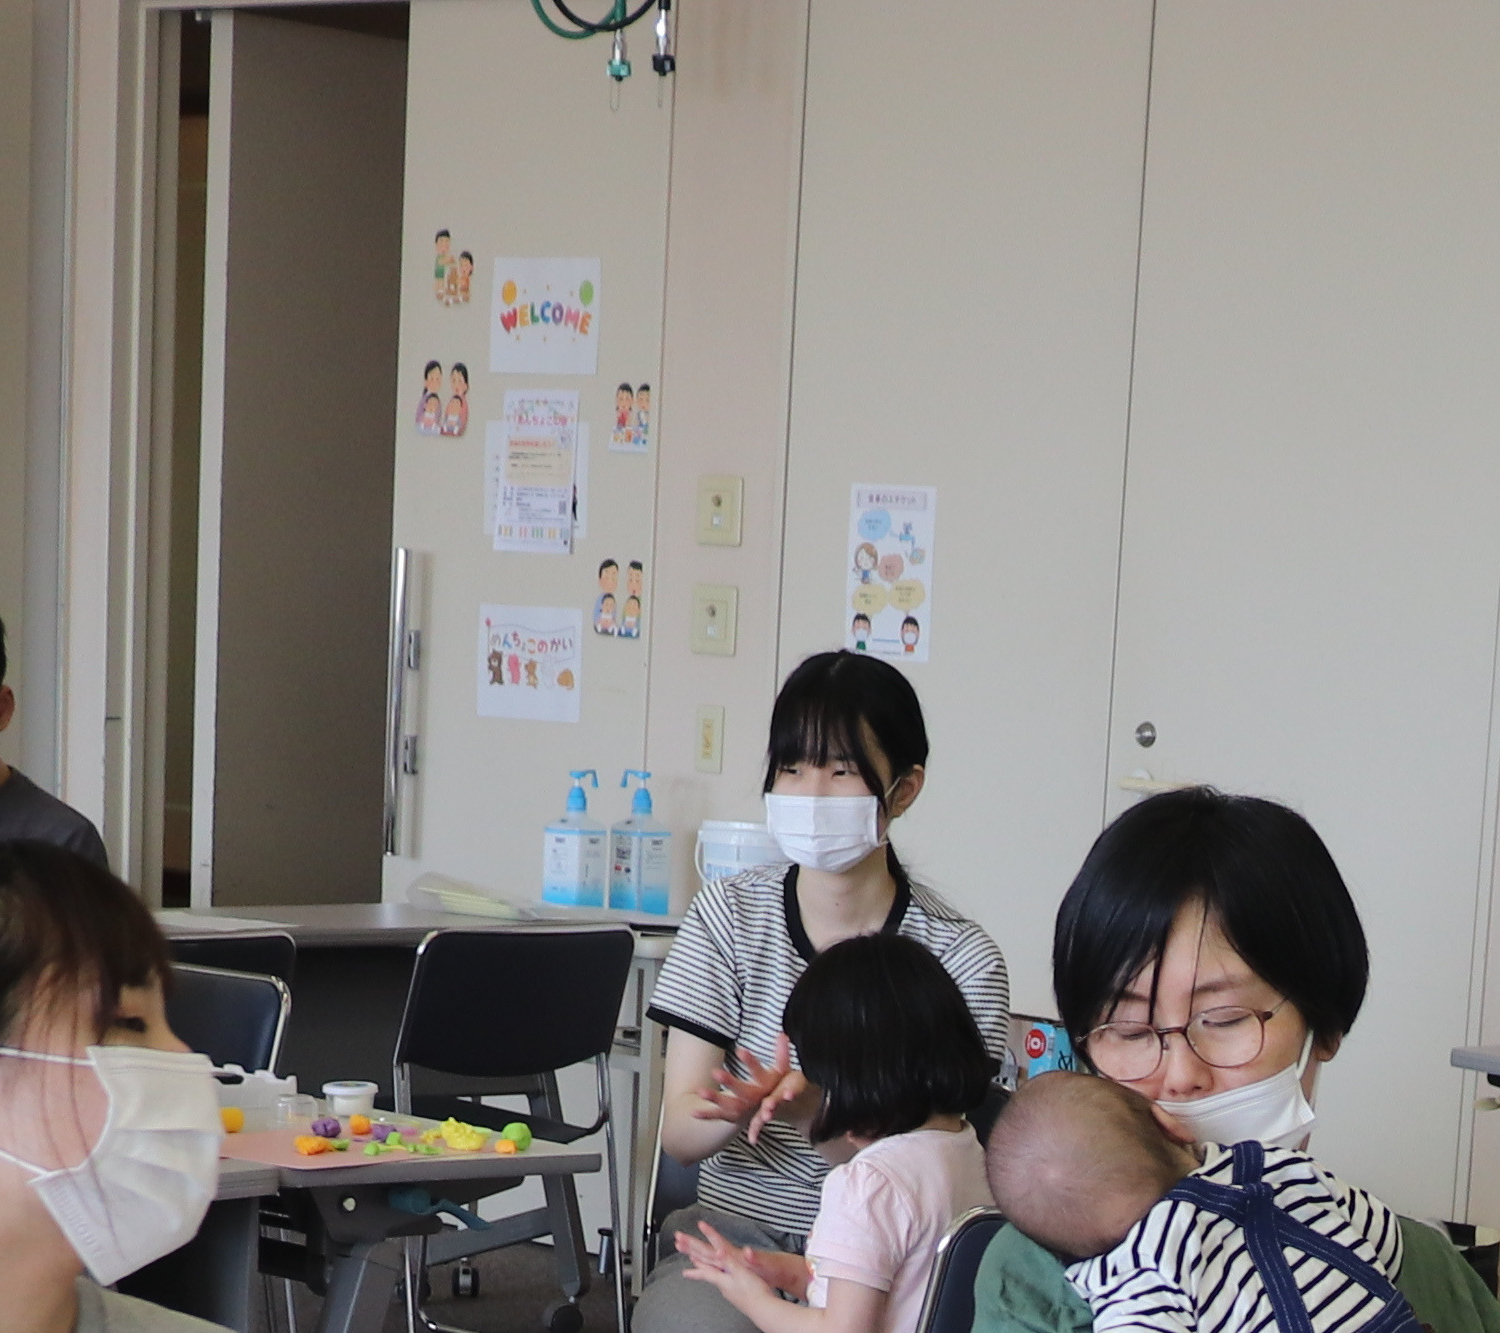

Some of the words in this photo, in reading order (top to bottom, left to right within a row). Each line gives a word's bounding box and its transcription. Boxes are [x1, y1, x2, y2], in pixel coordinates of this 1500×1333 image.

[500, 300, 592, 335] WELCOME
[490, 631, 573, 655] めんちょこのかい
